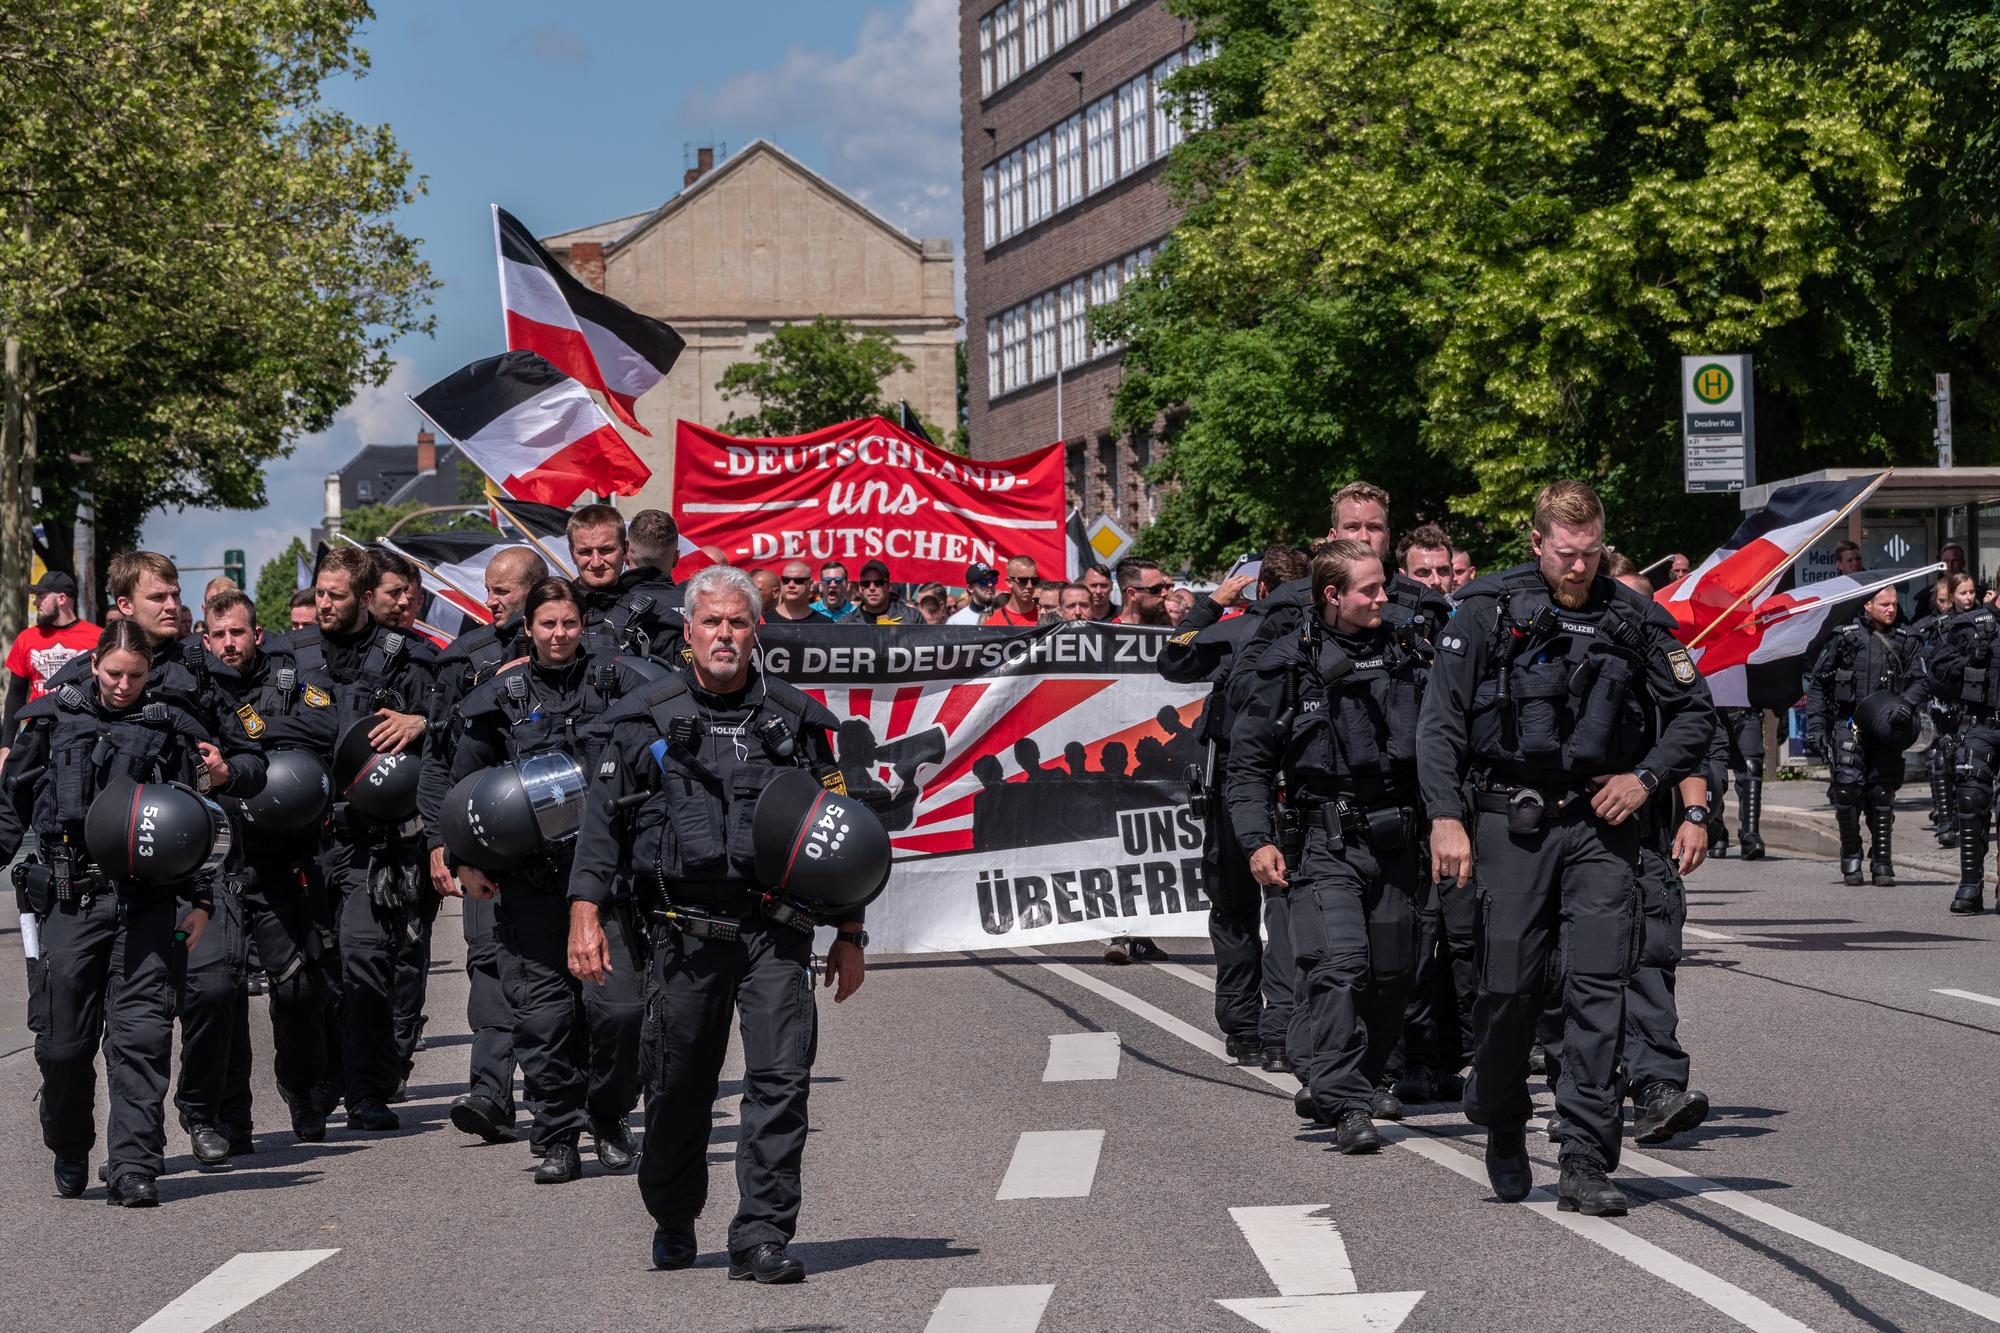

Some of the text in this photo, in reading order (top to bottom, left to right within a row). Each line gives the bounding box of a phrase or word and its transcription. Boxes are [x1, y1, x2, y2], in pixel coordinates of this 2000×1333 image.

[1705, 372, 1722, 396] H
[1694, 419, 1736, 428] Dresdner Platz
[827, 479, 929, 516] uns
[1562, 622, 1595, 634] POLIZEI
[802, 647, 875, 673] DER
[887, 634, 1102, 674] DEUTSCHEN
[1114, 634, 1173, 662] ZU
[1355, 659, 1383, 669] POLIZEI
[710, 726, 745, 735] POLIZEI
[138, 805, 159, 857] 5413
[805, 804, 845, 859] 5410
[976, 857, 1211, 936] ÜBERFRE
